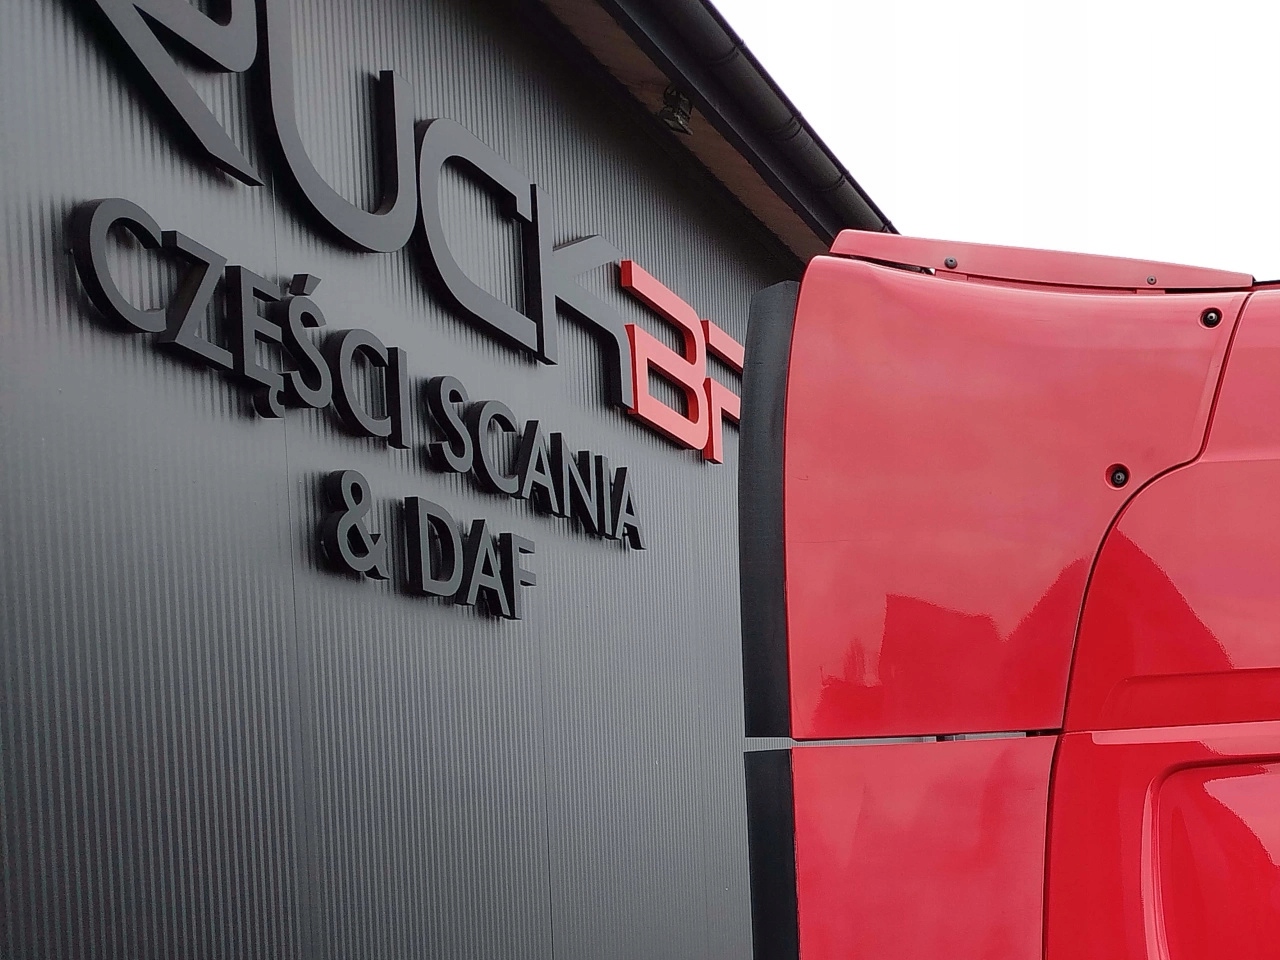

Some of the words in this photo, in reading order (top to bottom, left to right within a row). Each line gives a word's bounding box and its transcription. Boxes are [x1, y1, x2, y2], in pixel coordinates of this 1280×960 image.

[74, 198, 411, 450] CZĘŚCI
[427, 376, 646, 550] SCANIA
[322, 469, 390, 580] &
[404, 496, 537, 620] DAF
